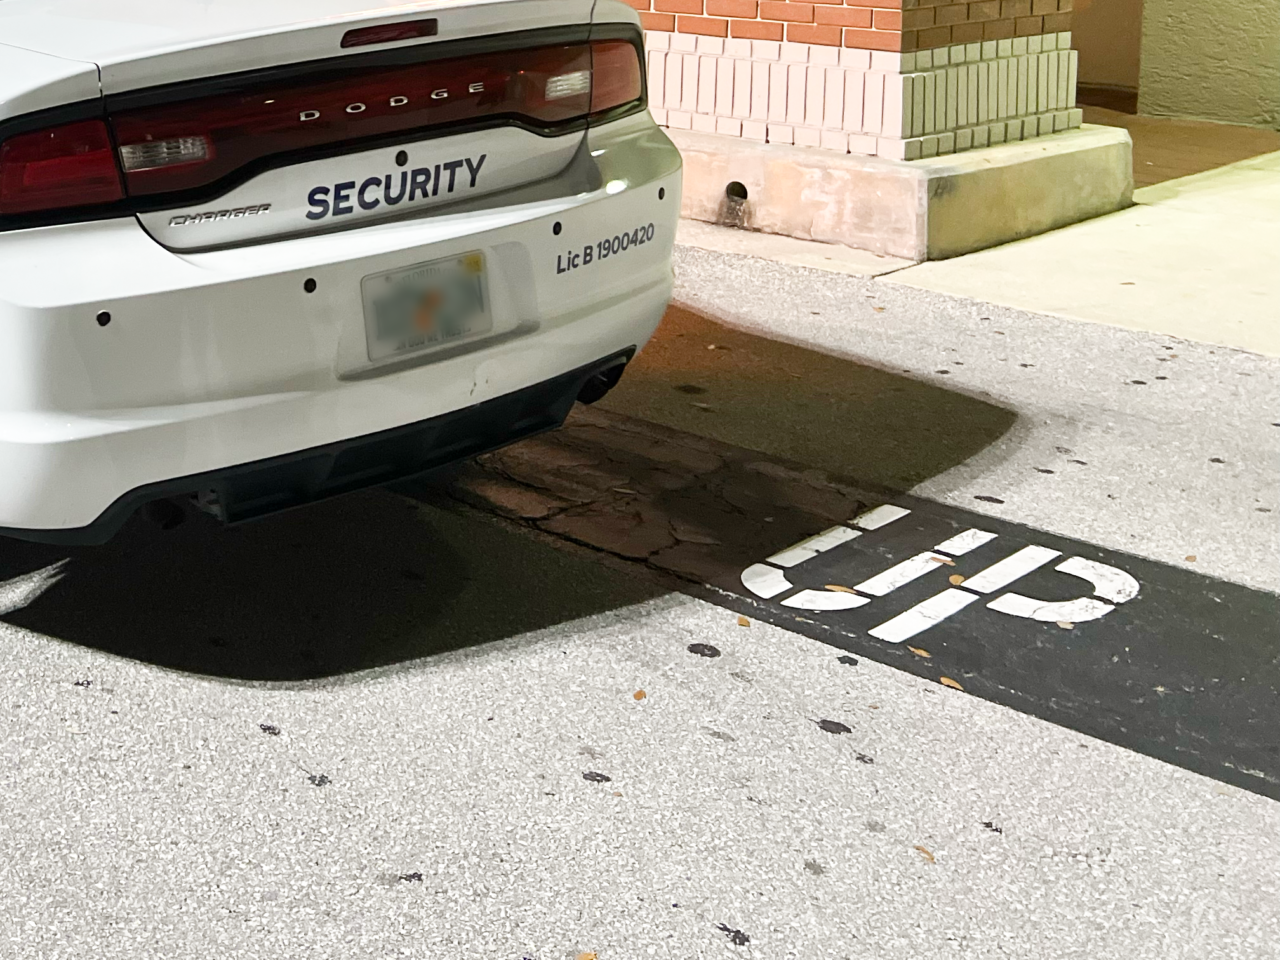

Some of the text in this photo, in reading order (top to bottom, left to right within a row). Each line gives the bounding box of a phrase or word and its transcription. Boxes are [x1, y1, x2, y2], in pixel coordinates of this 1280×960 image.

[299, 82, 485, 122] DODGE
[305, 153, 487, 221] SECURITY
[168, 203, 272, 227] CHARGER
[556, 222, 655, 275] Lic B 1900420
[740, 503, 1141, 644] UP
